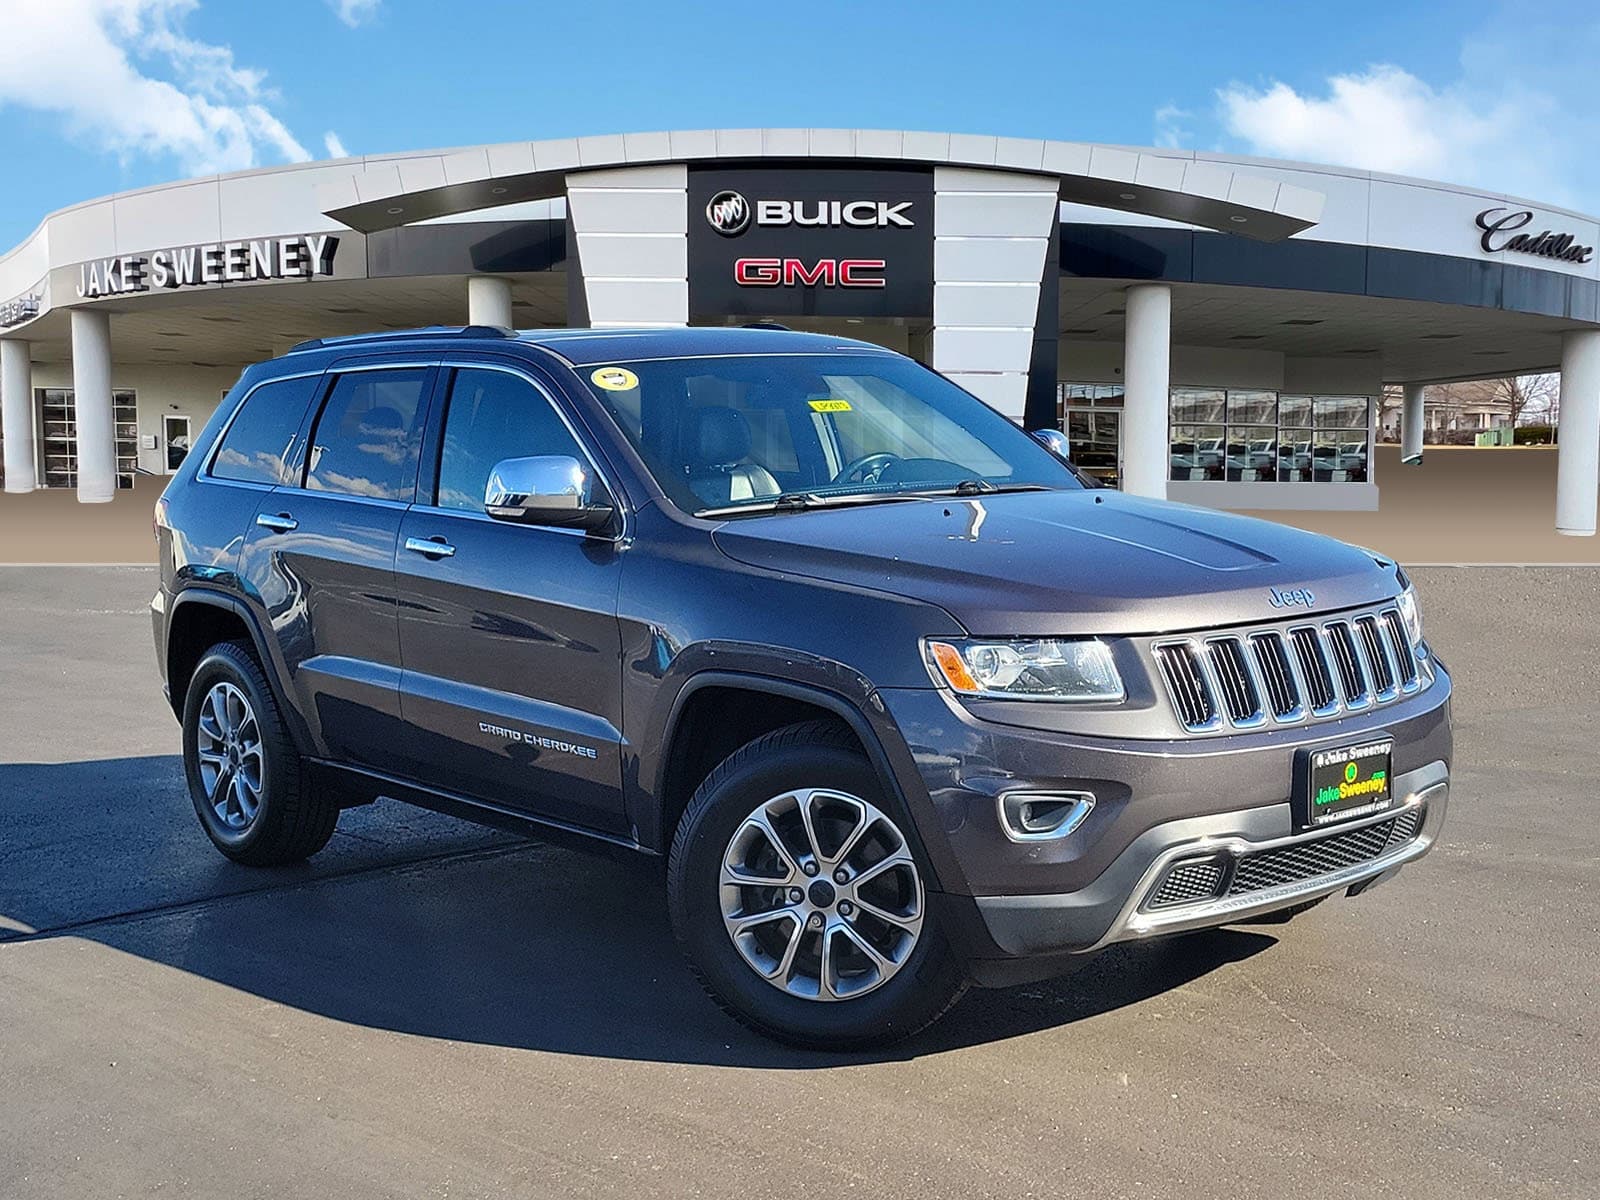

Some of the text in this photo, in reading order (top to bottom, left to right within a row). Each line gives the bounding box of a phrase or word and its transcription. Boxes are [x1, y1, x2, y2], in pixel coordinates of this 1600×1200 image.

[757, 200, 914, 226] BUICK
[1475, 207, 1593, 263] Cadillac
[76, 235, 334, 297] JAKE SWEENEY
[735, 258, 885, 286] GMC
[1268, 586, 1315, 608] Jeep
[479, 722, 597, 759] GRAND CHEROKEE
[1349, 743, 1391, 759] Sweeney
